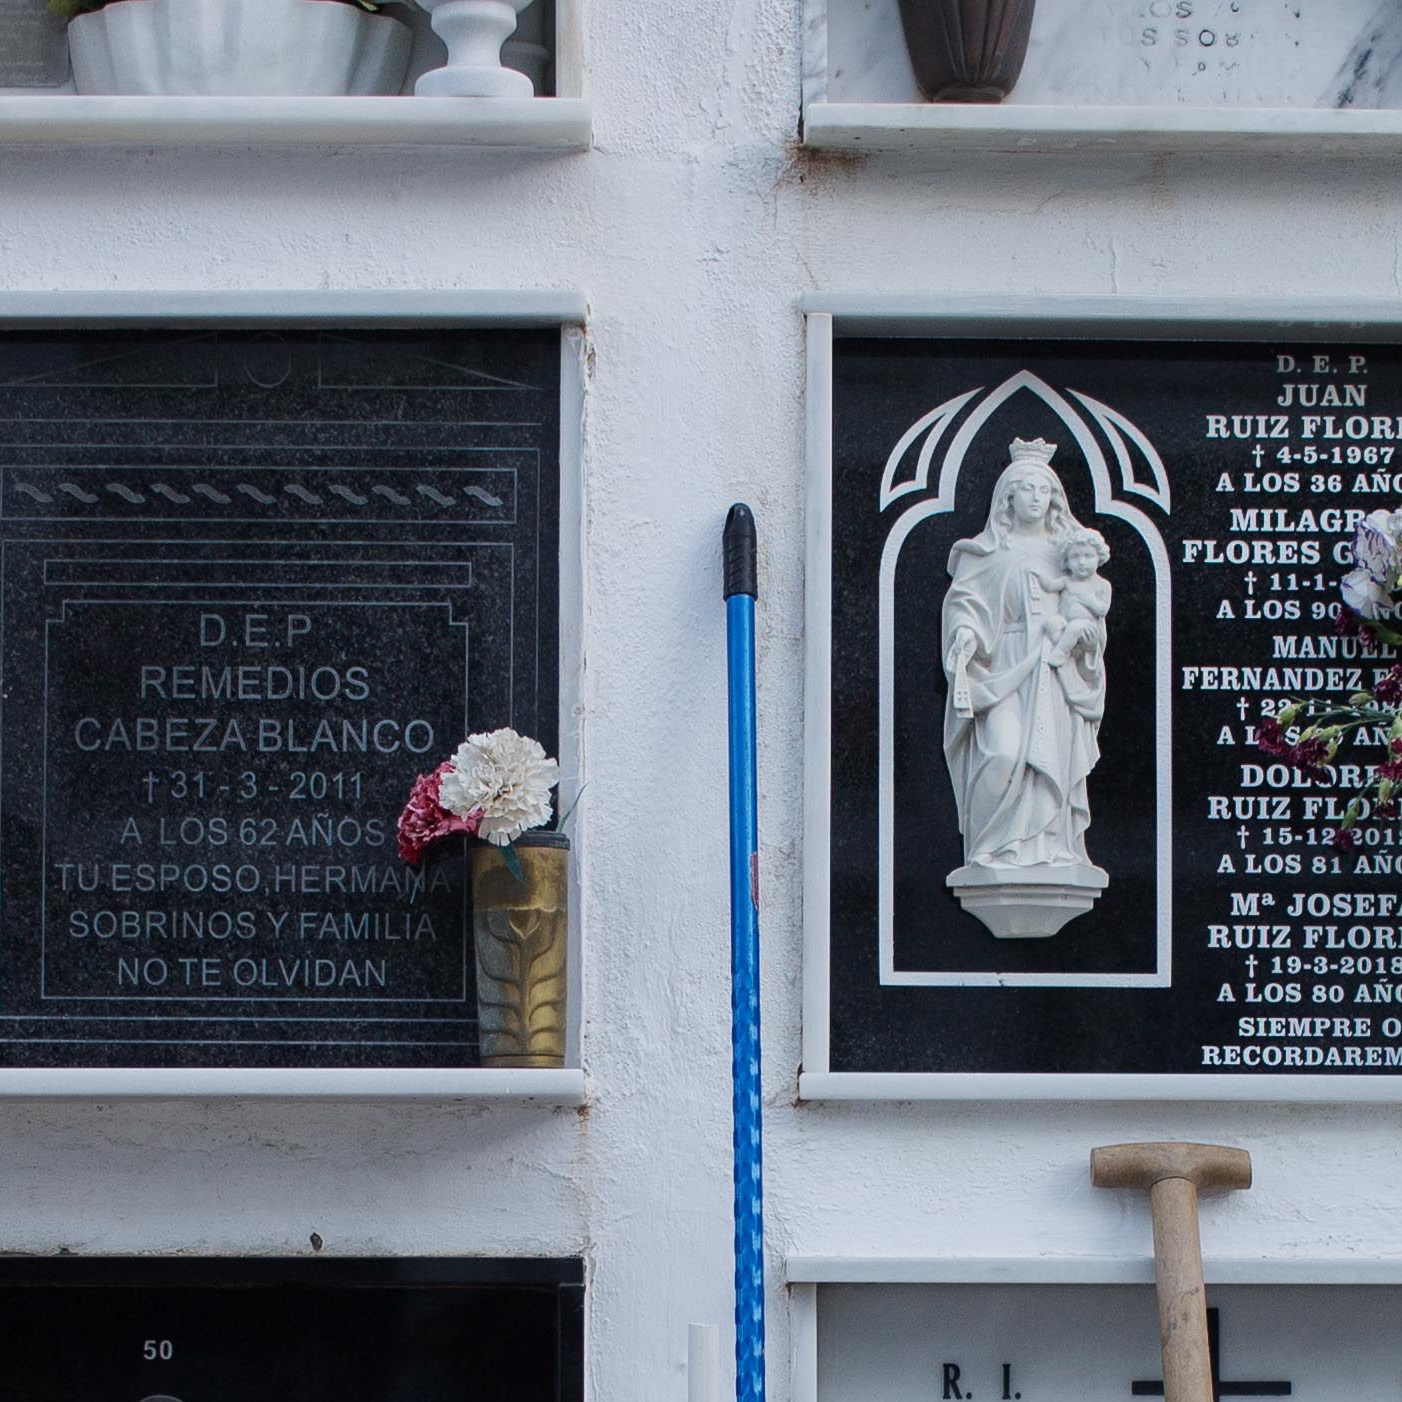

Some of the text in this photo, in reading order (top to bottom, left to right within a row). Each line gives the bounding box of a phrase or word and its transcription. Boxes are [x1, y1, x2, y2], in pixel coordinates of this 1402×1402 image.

[1277, 383, 1368, 407] JUAN
[1205, 414, 1290, 439] RUIZ
[1276, 445, 1395, 465] 4-5-1967
[1215, 472, 1235, 492] A
[1243, 472, 1301, 493] LOS
[1310, 474, 1343, 493] 36
[1182, 539, 1321, 565] FLORES
[1215, 599, 1236, 619] A
[1243, 599, 1301, 620] LOS
[141, 664, 370, 701] REMEDIOS
[1181, 666, 1365, 692] FERNANDEZ
[74, 717, 434, 754] CABEZA BLANCO
[1207, 795, 1291, 820] RUIZ
[120, 812, 385, 847] A LOS 62 AÑOS
[53, 861, 99, 892] TU
[1216, 853, 1236, 874] A
[1244, 853, 1302, 874] LOS
[1311, 855, 1342, 875] 81
[69, 909, 436, 943] SOBRINOS Y FAMILIA
[1207, 924, 1292, 949] RUIZ
[117, 957, 386, 987] NO TE OLVIDAN
[1216, 982, 1237, 1002] A
[1245, 982, 1302, 1003] LOS
[1311, 984, 1345, 1003] 80
[1238, 1016, 1371, 1038] SIEMPRE
[143, 1339, 173, 1361] 50
